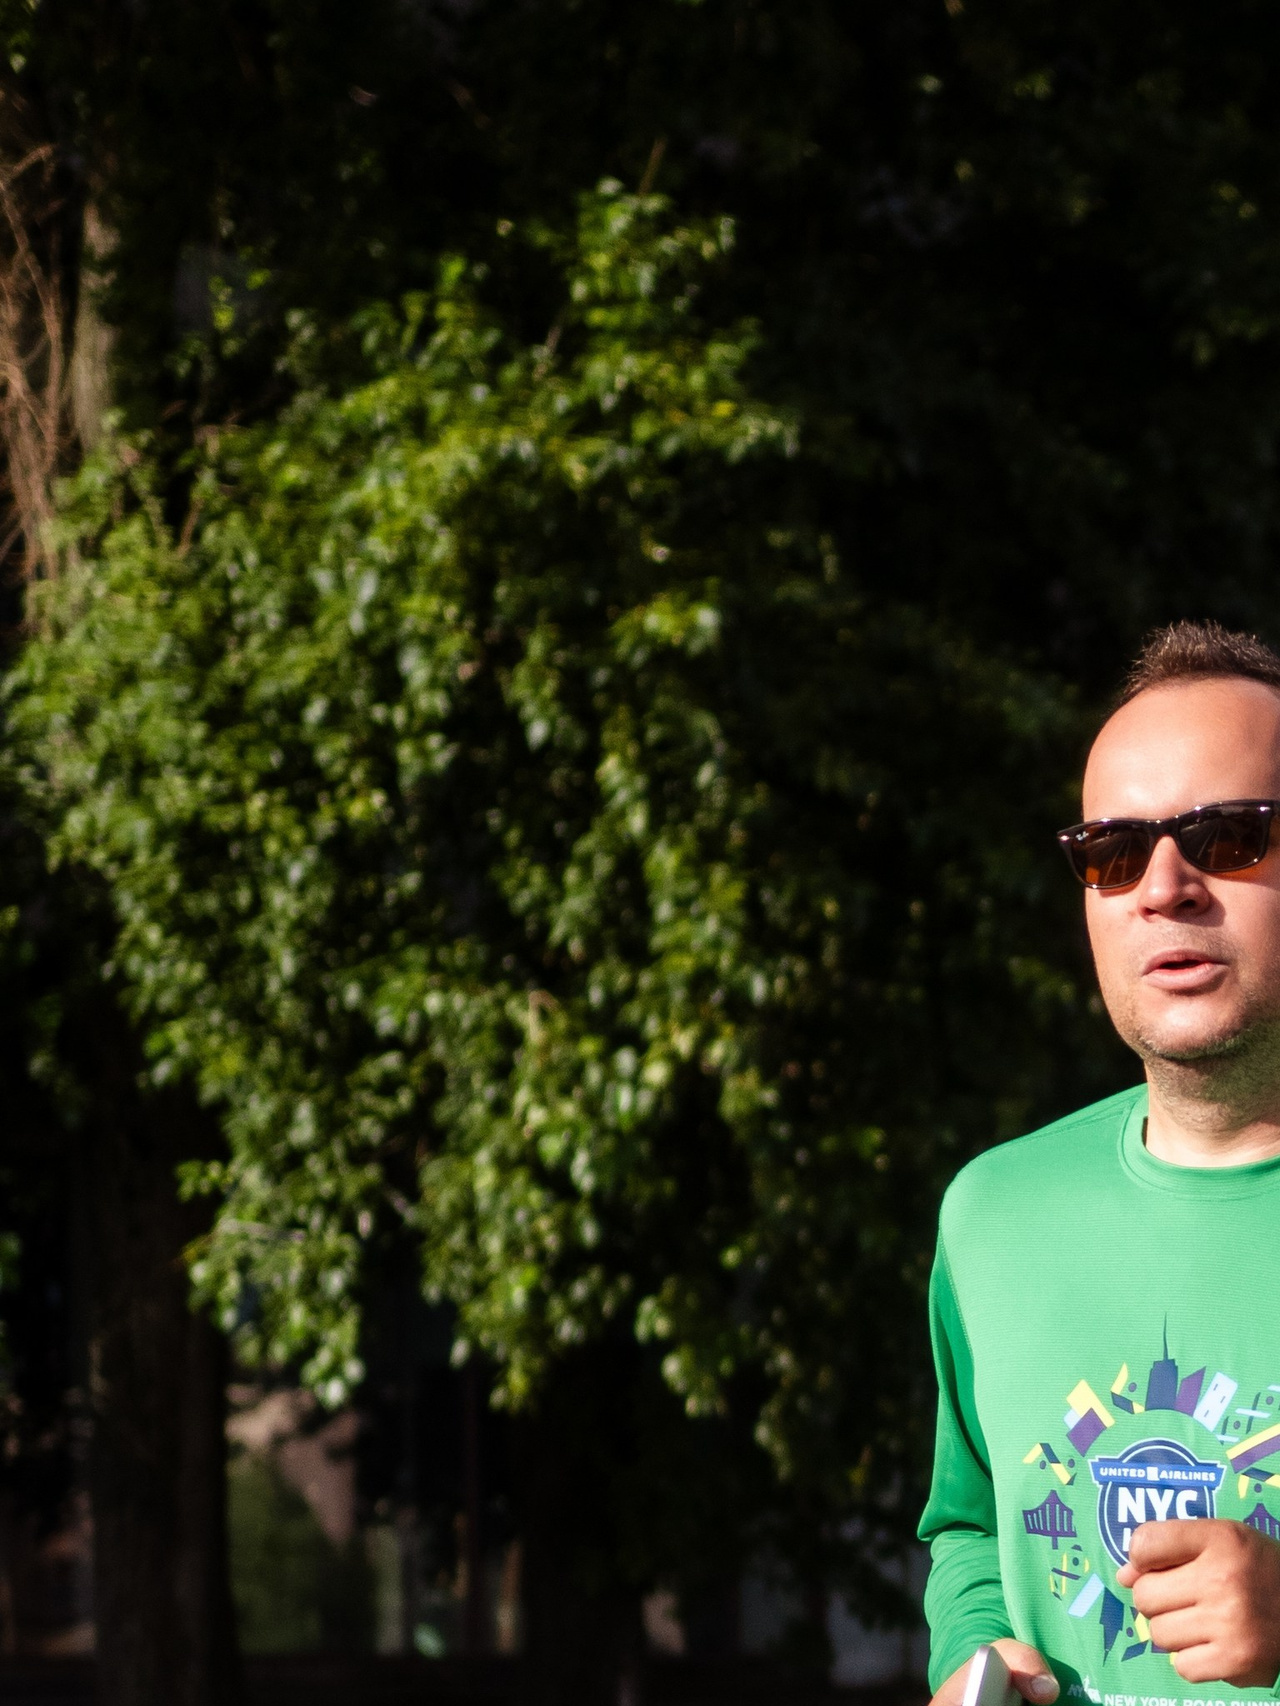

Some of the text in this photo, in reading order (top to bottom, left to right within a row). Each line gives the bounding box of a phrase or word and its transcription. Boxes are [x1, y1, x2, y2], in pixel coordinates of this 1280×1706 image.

[1099, 1467, 1216, 1482] UNITED AIRLINES
[1117, 1486, 1198, 1523] NYC
